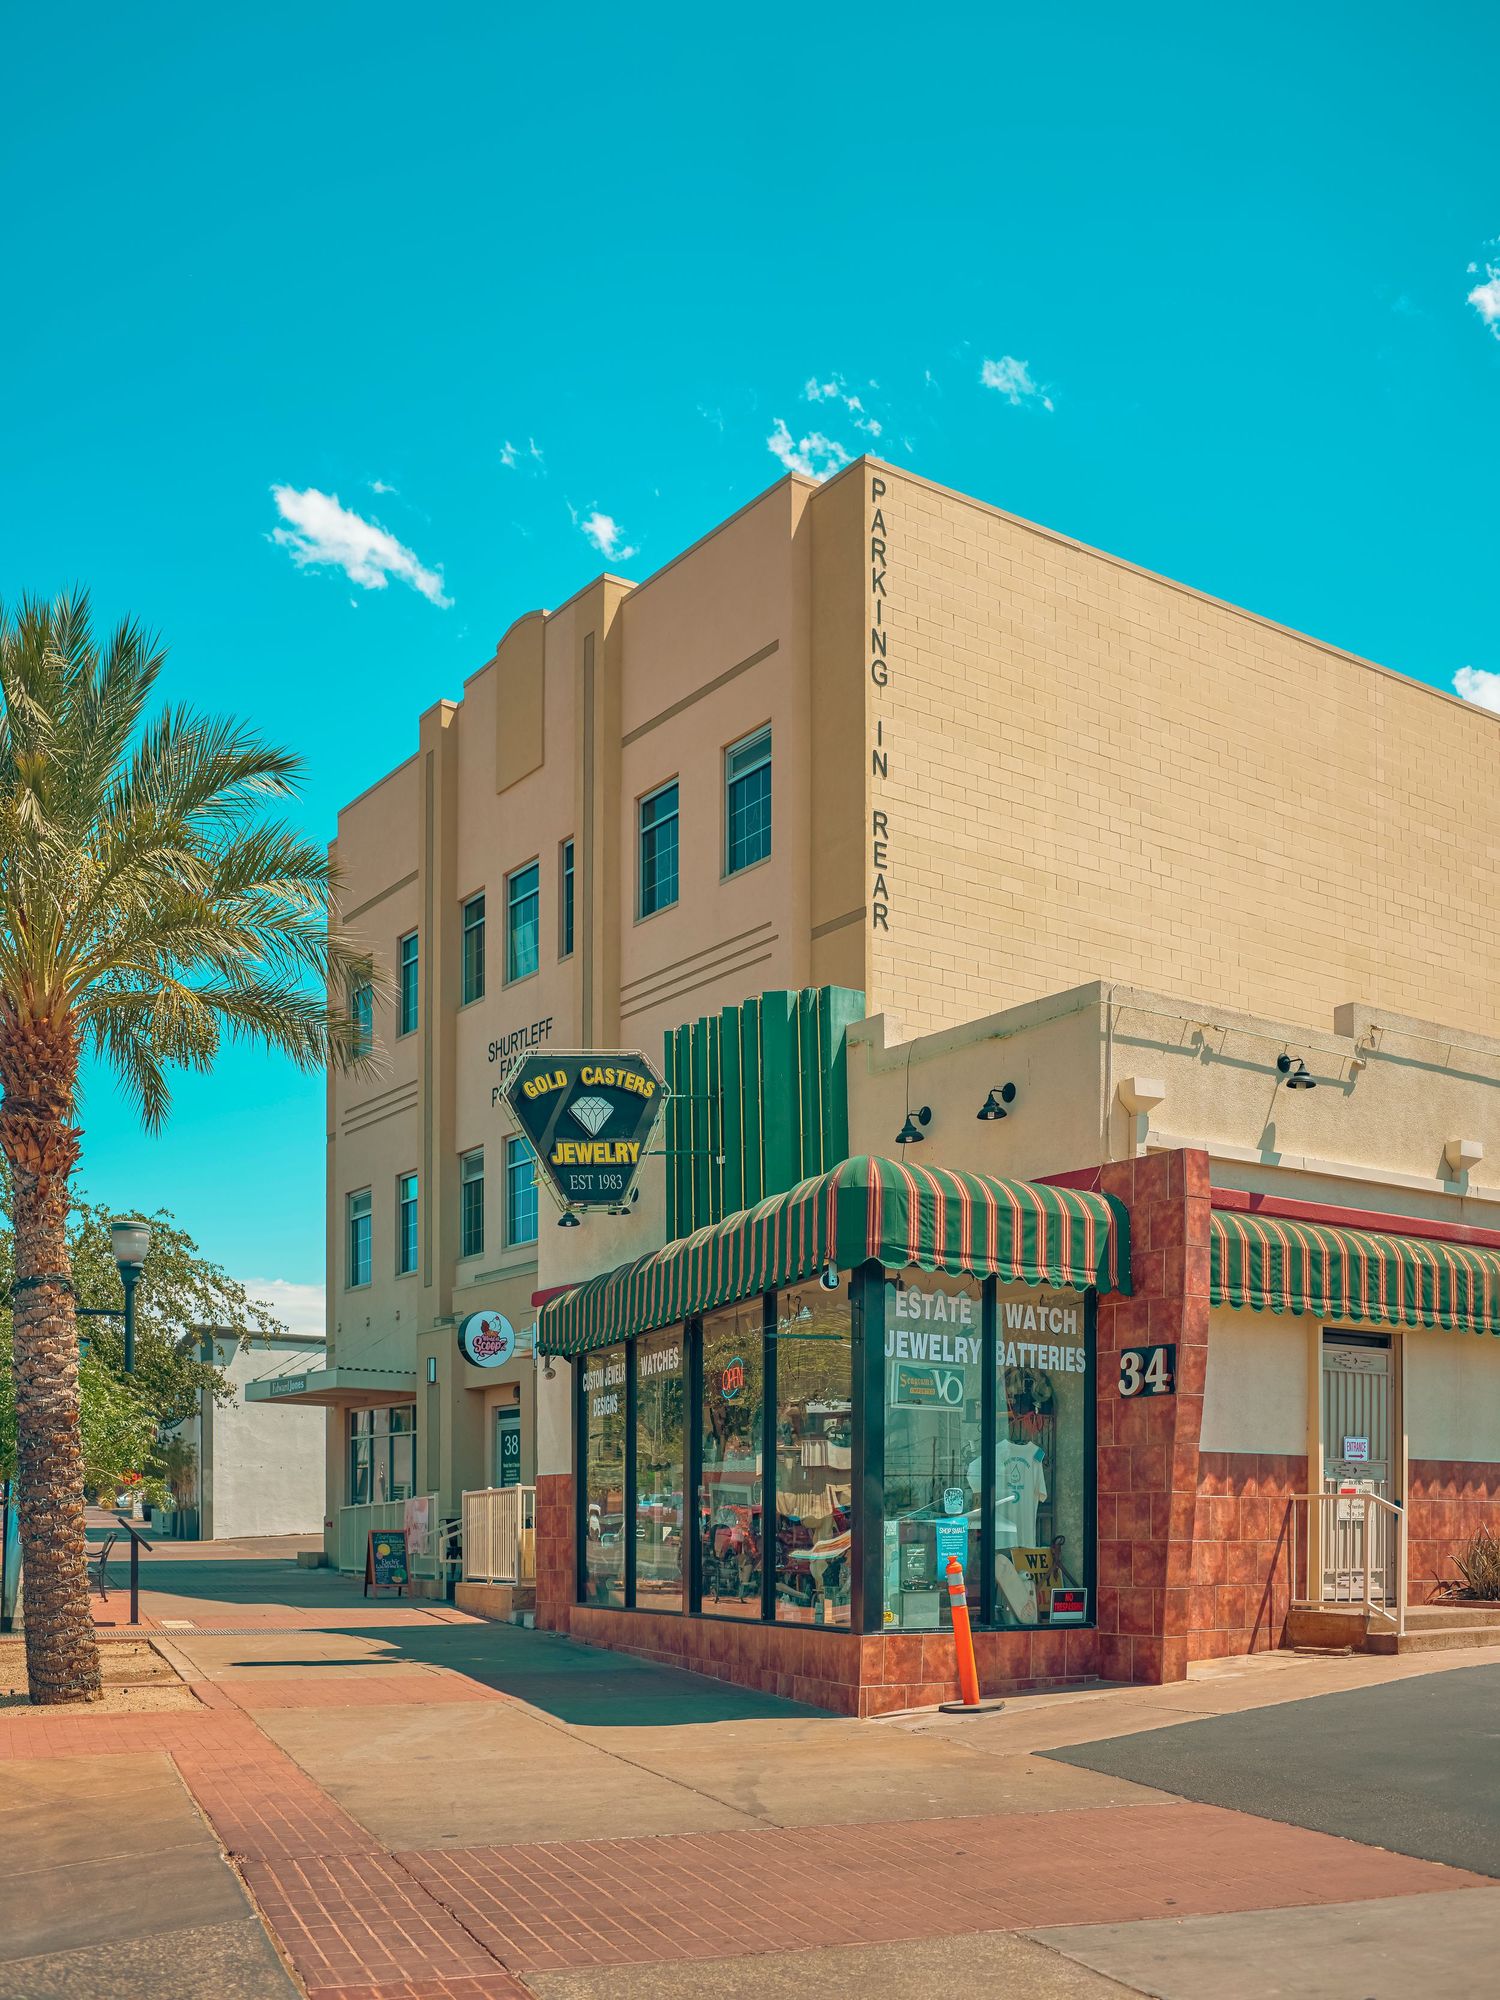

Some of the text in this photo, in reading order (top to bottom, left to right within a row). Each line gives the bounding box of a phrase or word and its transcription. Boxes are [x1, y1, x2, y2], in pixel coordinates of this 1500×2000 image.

[871, 477, 889, 932] PARKING IN REAR
[488, 1017, 553, 1063] SHURTLEFF
[523, 1070, 568, 1099] GOLD
[581, 1066, 656, 1098] CASTERS
[551, 1142, 641, 1165] JEWELRY
[570, 1174, 623, 1190] EST 1983
[895, 1291, 972, 1324] ESTATE
[1005, 1303, 1077, 1335] WATCH
[641, 1347, 679, 1377] WATCHES
[884, 1330, 982, 1365] JEWELRY
[995, 1340, 1086, 1374] BATTERIES
[582, 1363, 626, 1392] CUSTOM JEWELR
[722, 1366, 744, 1390] OPEN
[1118, 1348, 1171, 1396] 34
[930, 1370, 963, 1404] VO
[593, 1393, 618, 1417] DESIGNS
[504, 1434, 519, 1456] 38
[1346, 1441, 1367, 1452] ENTRANCE
[939, 1526, 966, 1535] SHOP SMALL
[1025, 1554, 1048, 1569] WE
[1065, 1593, 1074, 1602] NO
